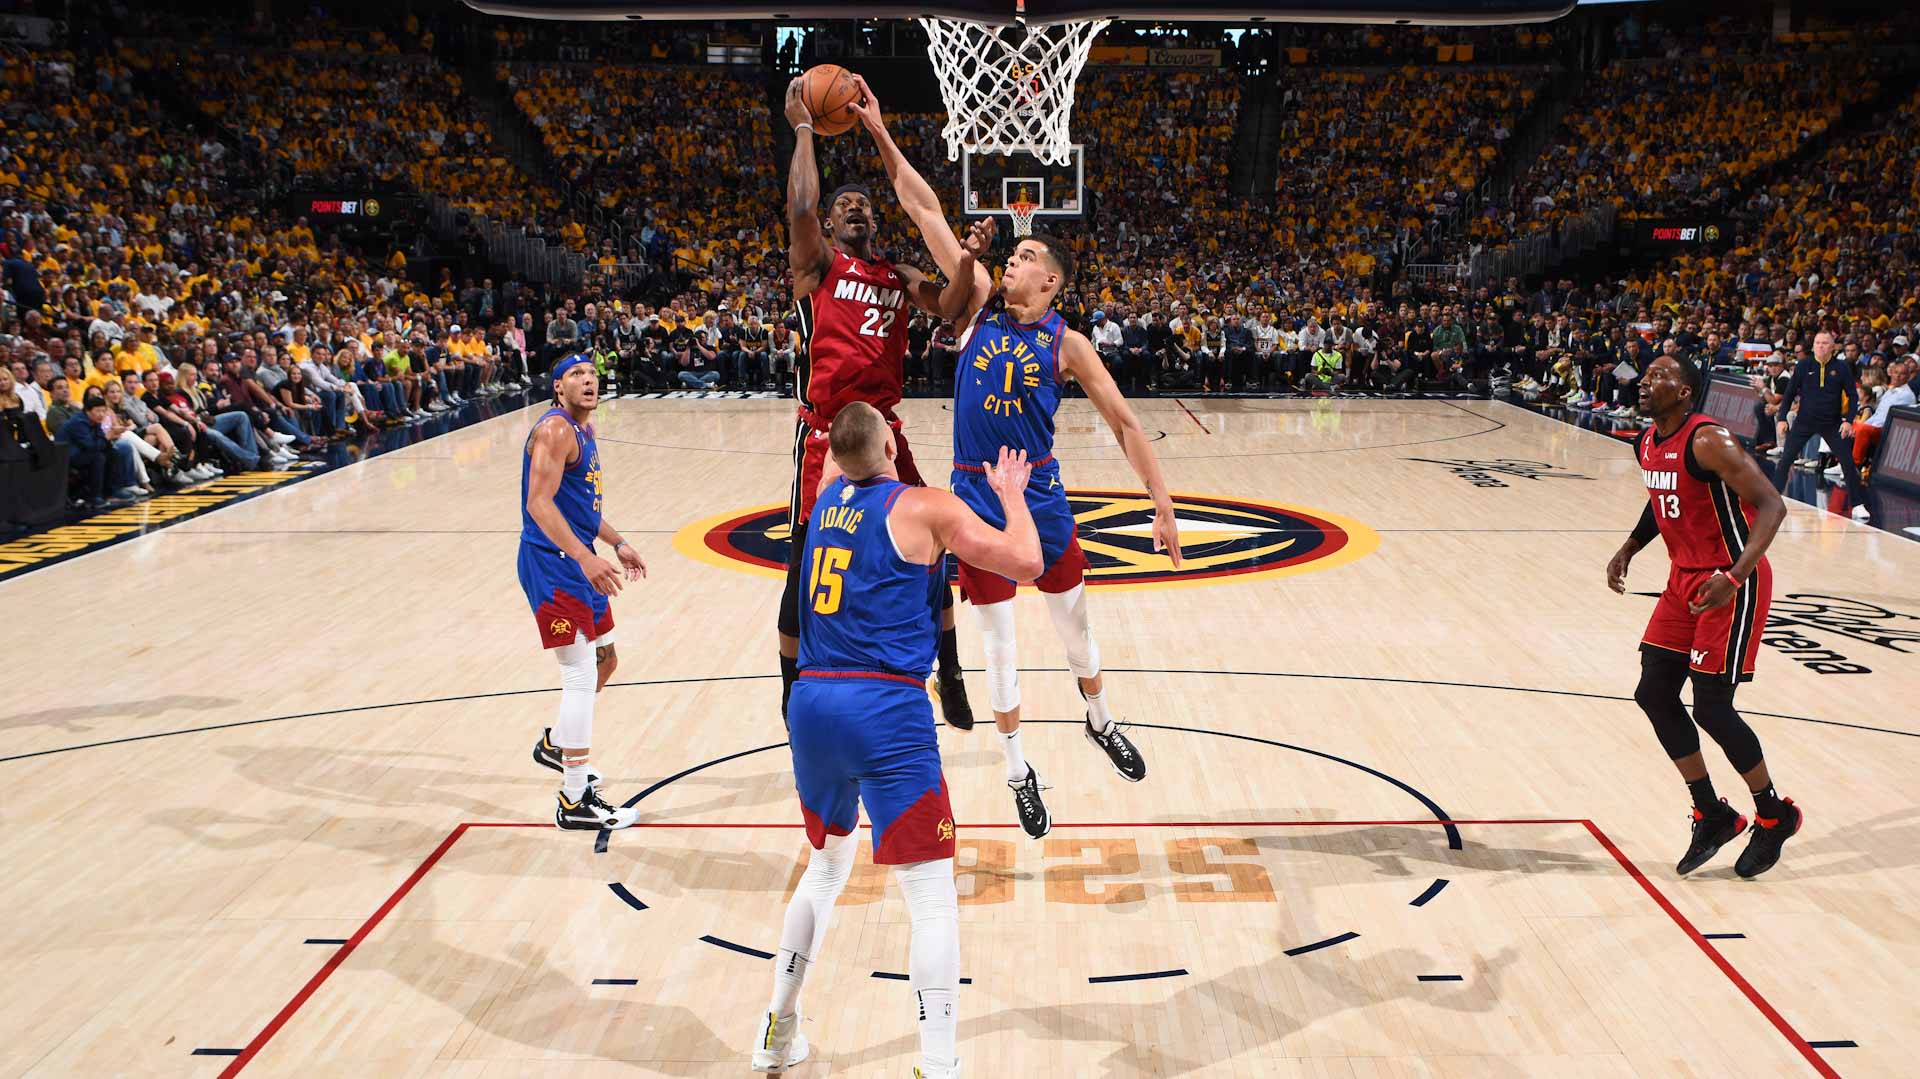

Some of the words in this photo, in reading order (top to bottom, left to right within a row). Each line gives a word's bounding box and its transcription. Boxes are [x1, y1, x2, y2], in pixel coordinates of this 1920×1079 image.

[1652, 228, 1697, 241] POINTSBET
[833, 279, 904, 310] MIAMI
[860, 307, 896, 337] 22
[973, 336, 1010, 371] MILE
[1012, 341, 1040, 387] HIGH
[1003, 361, 1014, 393] 1
[983, 394, 1023, 416] CITY
[819, 506, 865, 535] JOKIĆ
[1658, 494, 1680, 518] 13
[809, 546, 853, 615] 15
